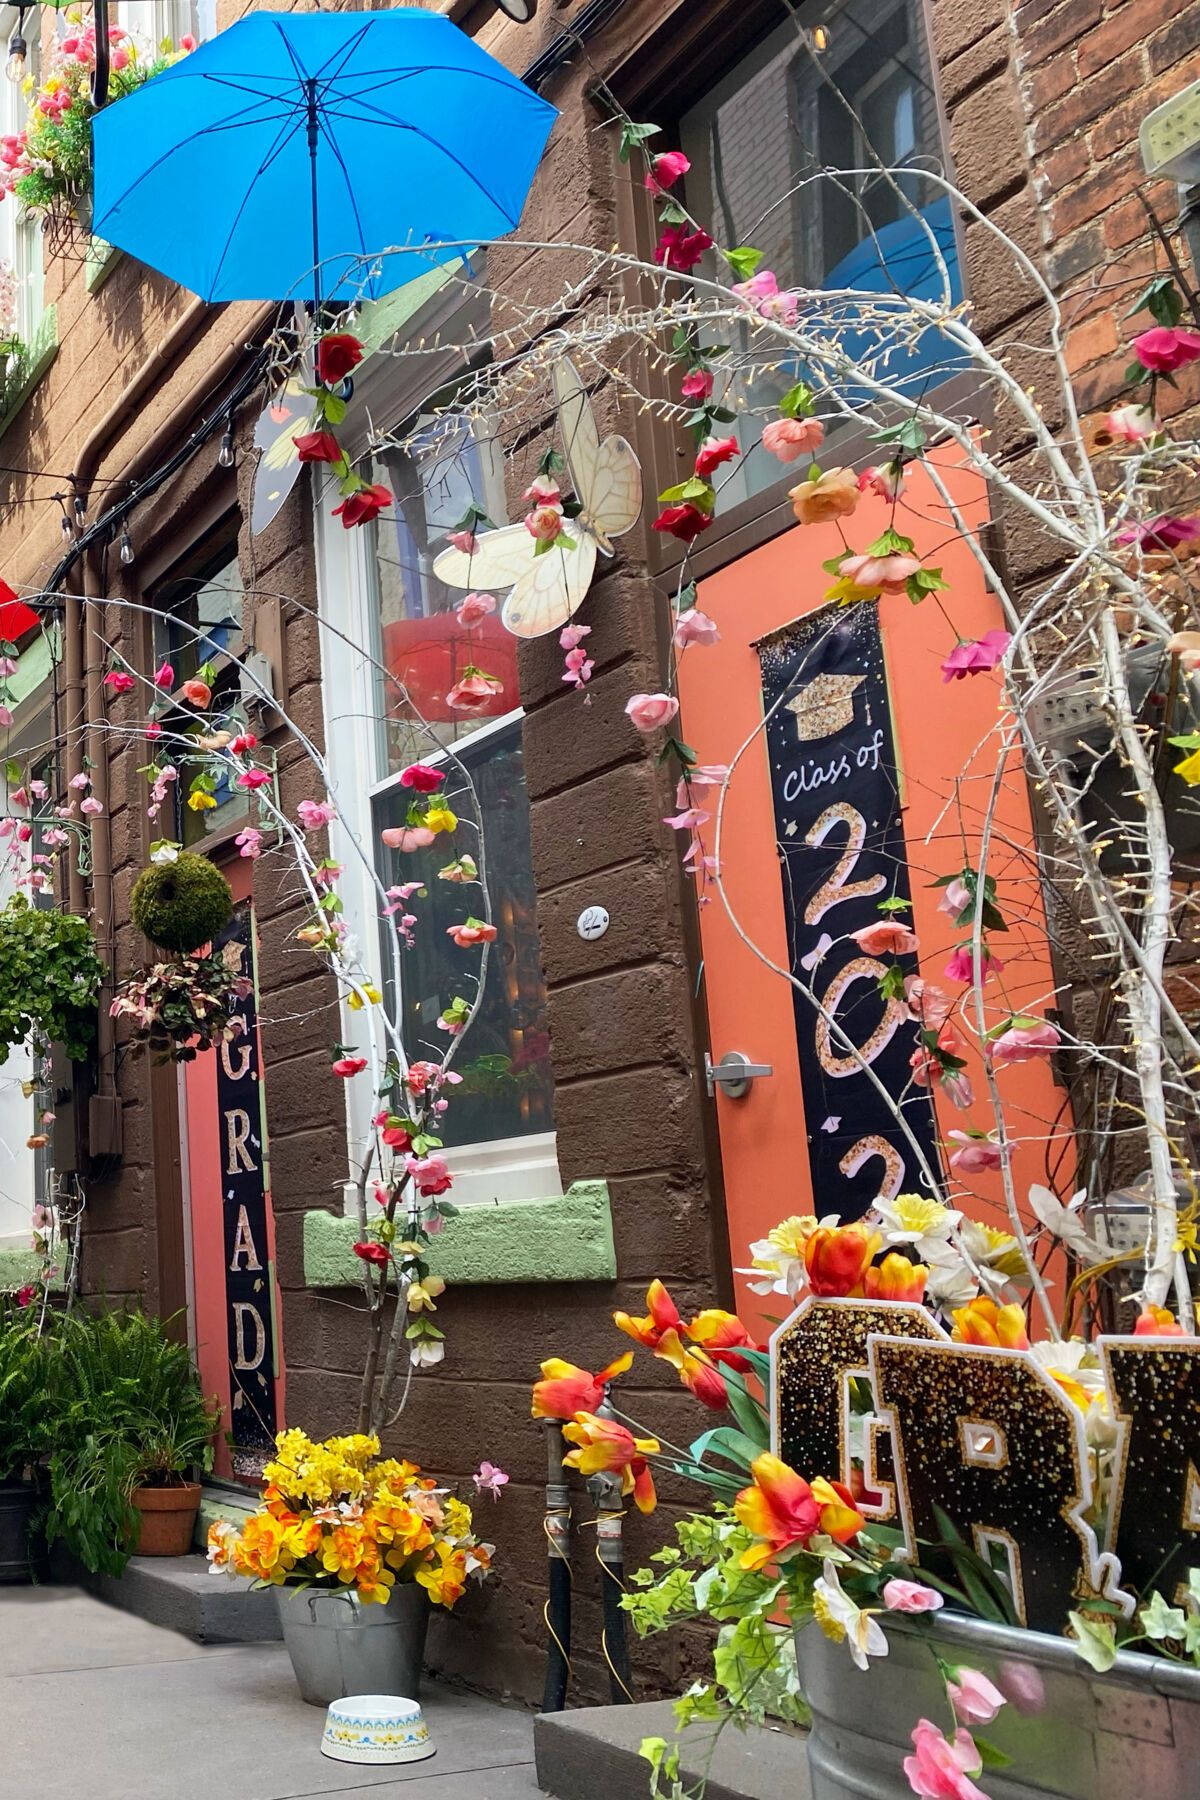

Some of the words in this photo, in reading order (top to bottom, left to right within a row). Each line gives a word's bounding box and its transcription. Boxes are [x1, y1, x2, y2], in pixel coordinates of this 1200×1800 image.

[784, 755, 851, 802] Class
[857, 729, 884, 771] of
[220, 1014, 266, 1371] GRAD
